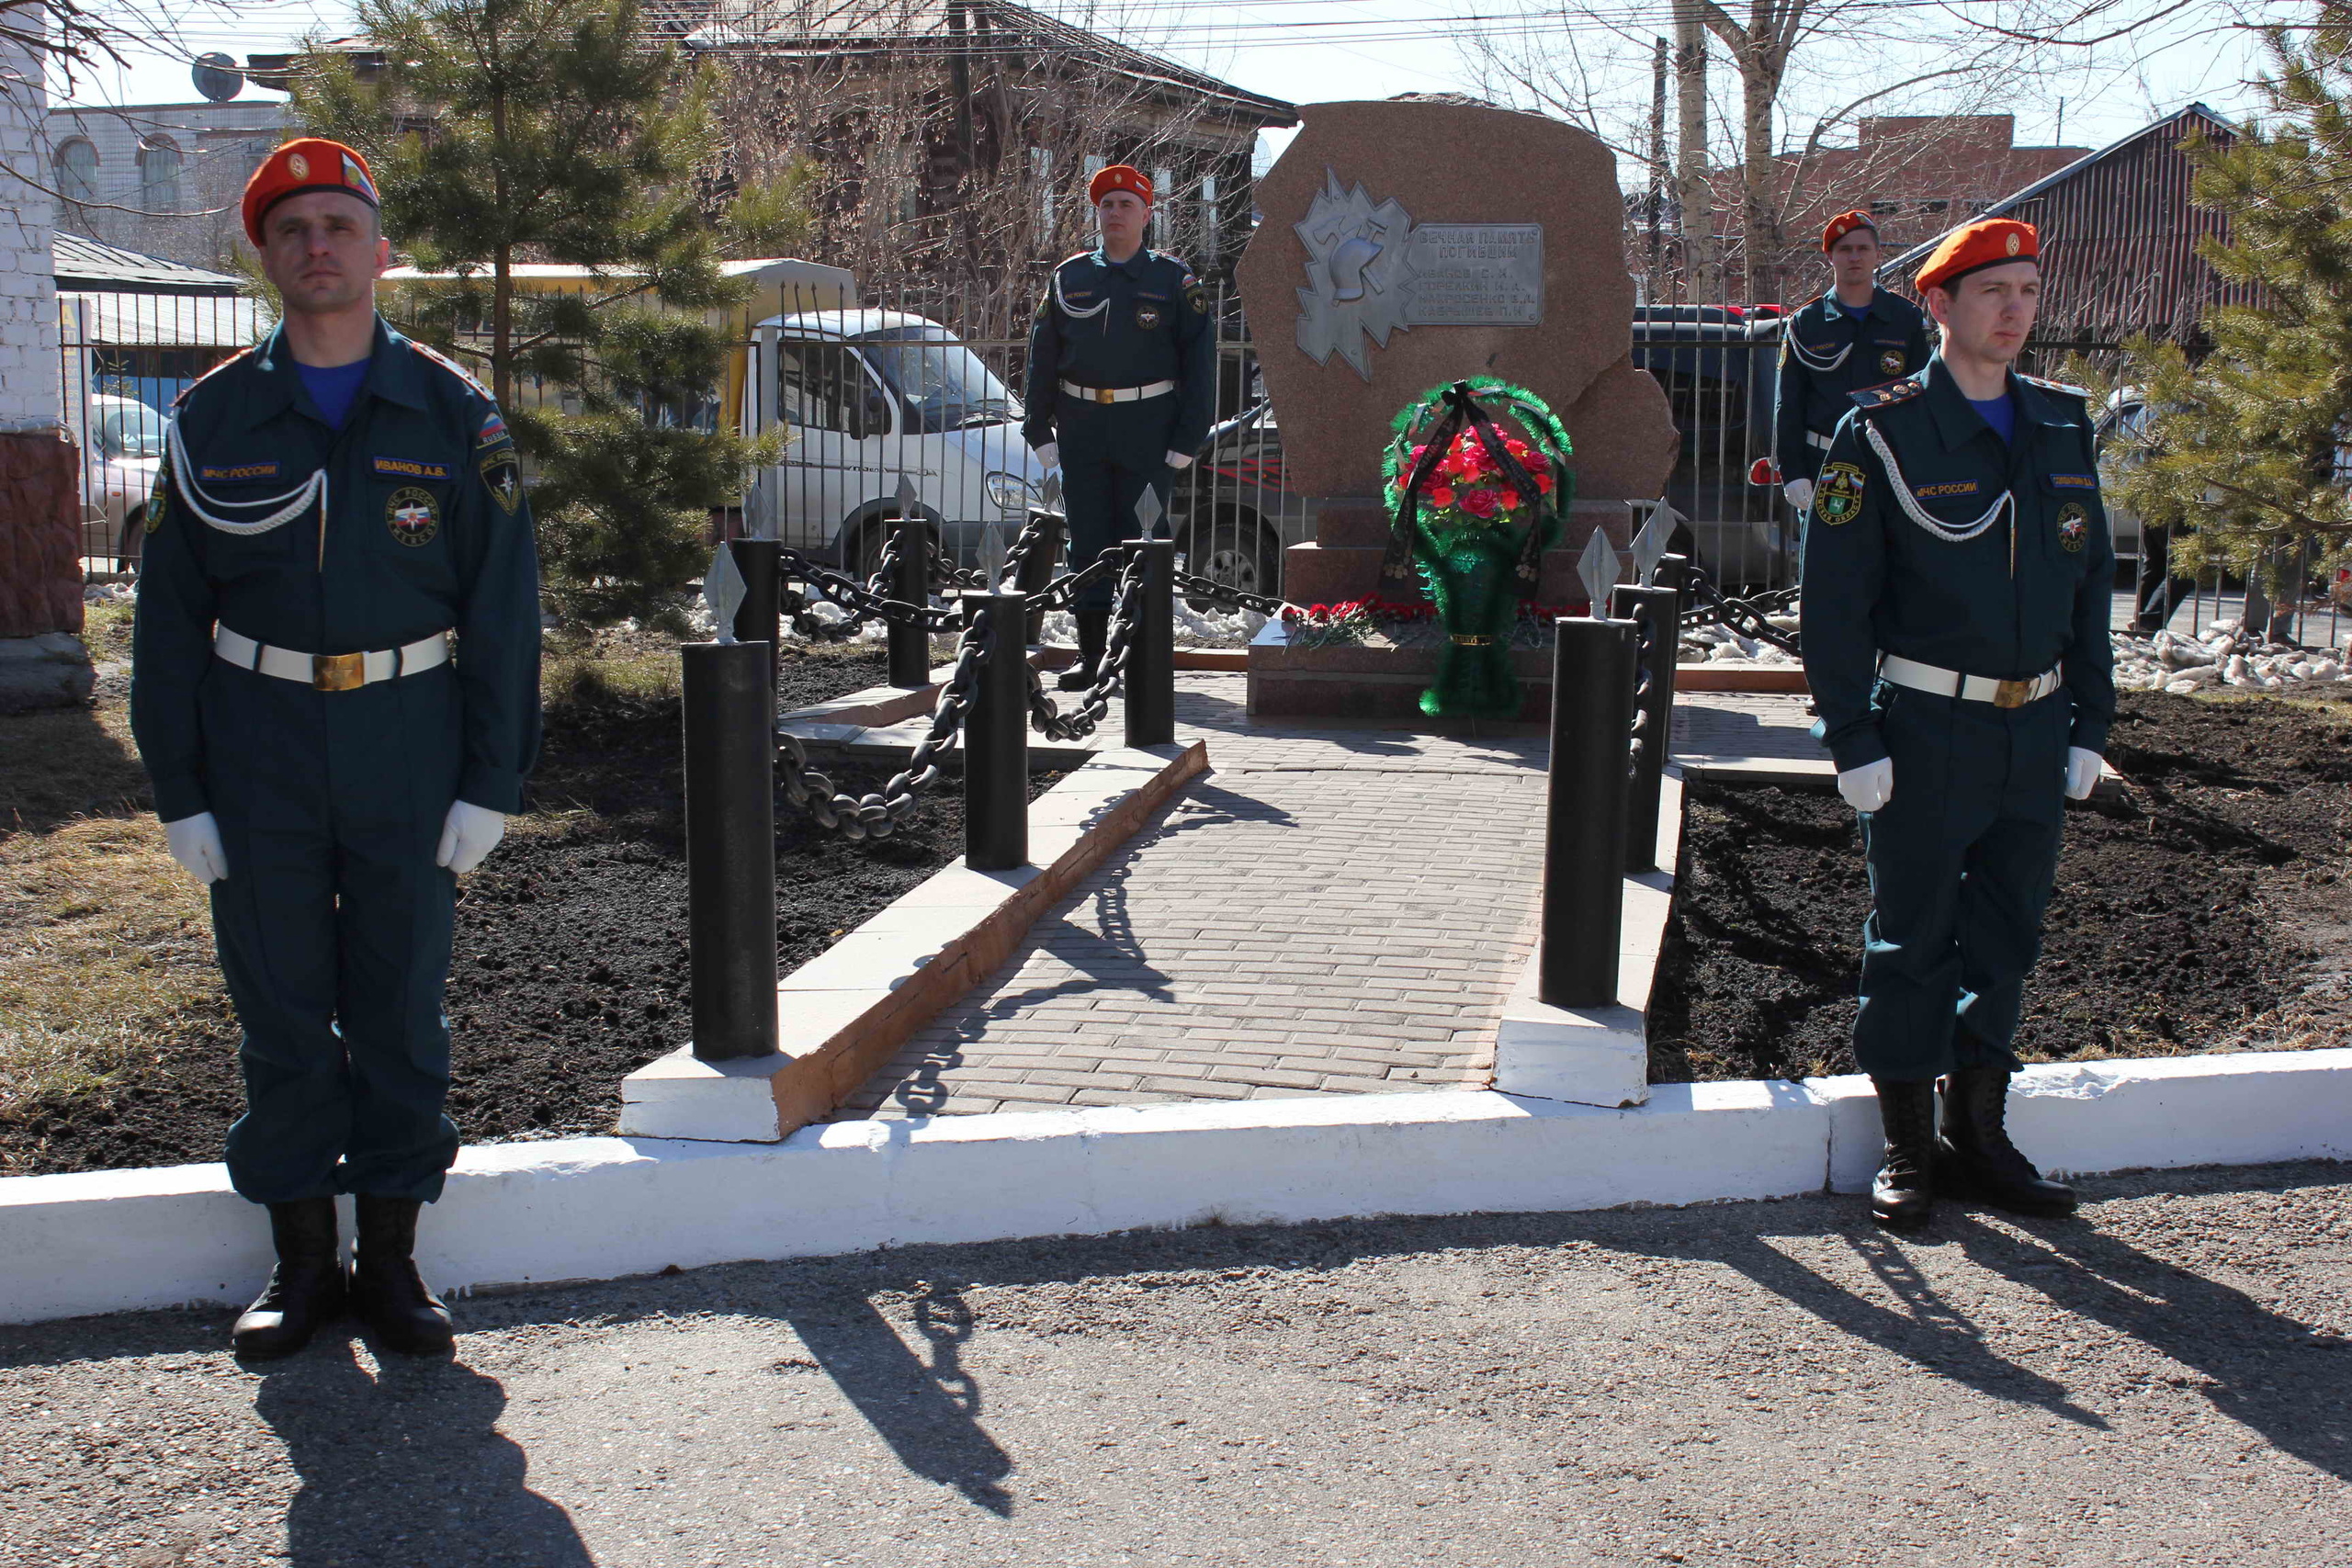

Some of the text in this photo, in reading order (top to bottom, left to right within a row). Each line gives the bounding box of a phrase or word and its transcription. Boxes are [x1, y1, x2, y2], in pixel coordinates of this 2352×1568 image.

[1419, 231, 1534, 244] ВЕЧНАЯ ПАМЯТЬ
[1439, 245, 1518, 259] ПОГИБШИМ
[375, 459, 422, 475] ИВАНОВ
[1917, 481, 1977, 497] МЧС РОССИИ
